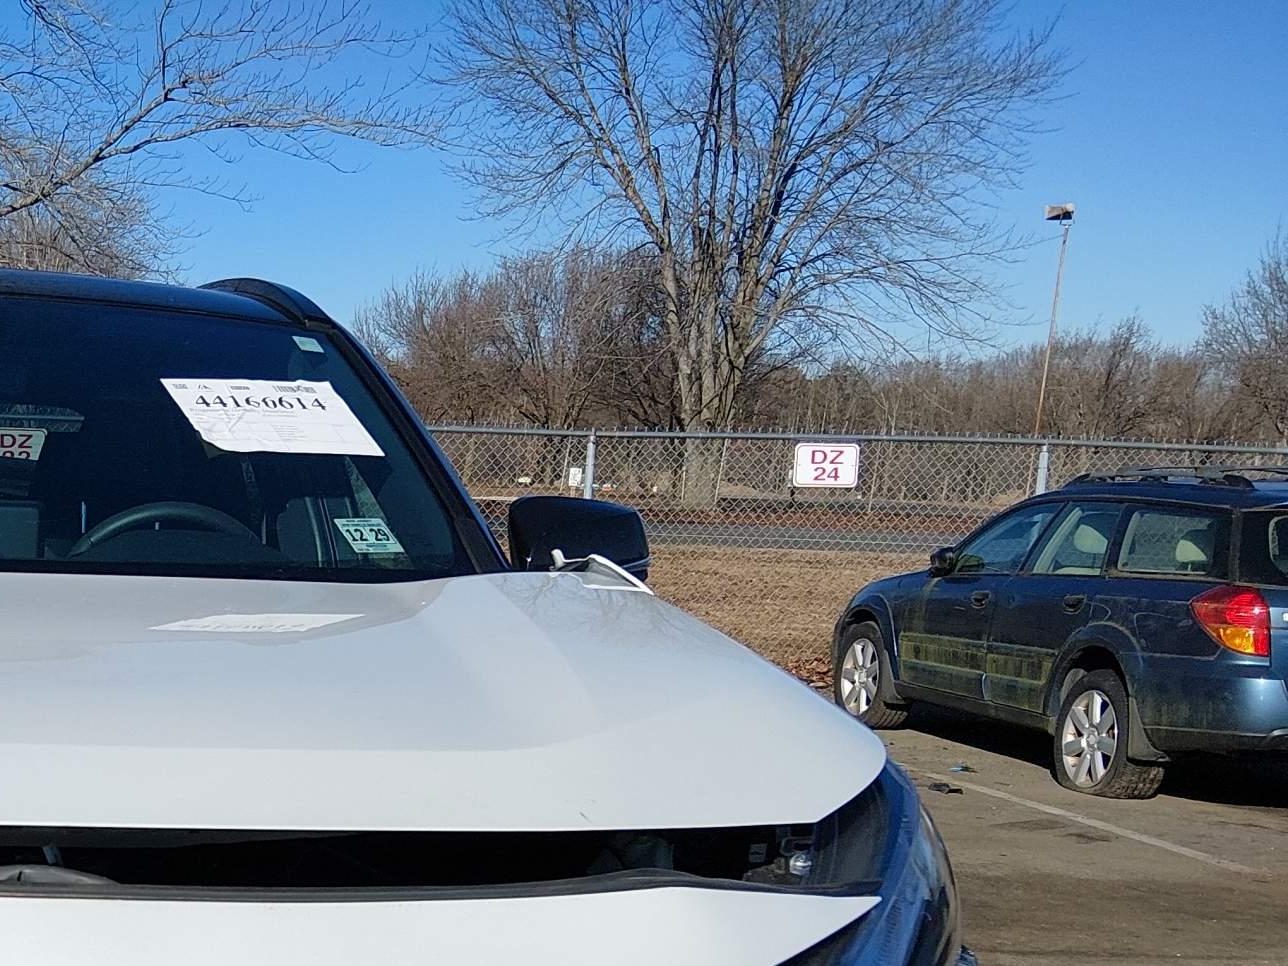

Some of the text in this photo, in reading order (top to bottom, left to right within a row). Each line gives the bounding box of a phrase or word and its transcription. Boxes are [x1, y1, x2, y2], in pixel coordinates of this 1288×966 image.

[0, 433, 33, 448] DZ
[810, 449, 845, 464] DZ
[813, 466, 840, 481] 24
[345, 527, 390, 541] 12 29
